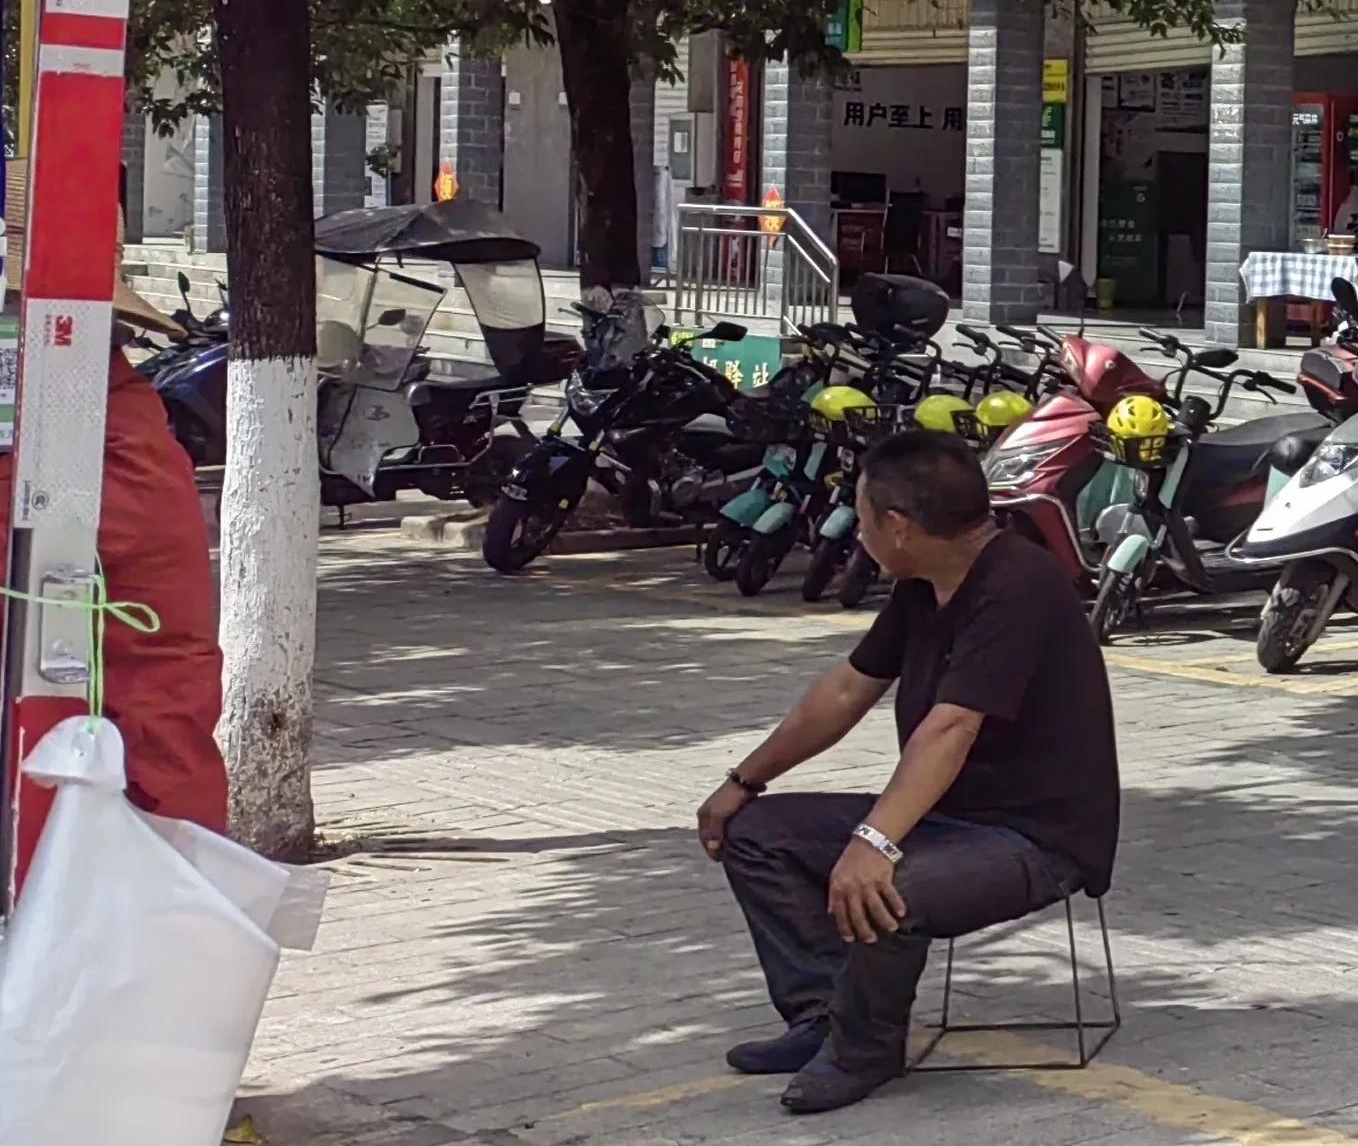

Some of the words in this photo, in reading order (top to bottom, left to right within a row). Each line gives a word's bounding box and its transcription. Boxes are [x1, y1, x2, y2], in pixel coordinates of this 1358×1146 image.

[843, 102, 934, 130] 用户至上
[54, 315, 73, 347] 3M
